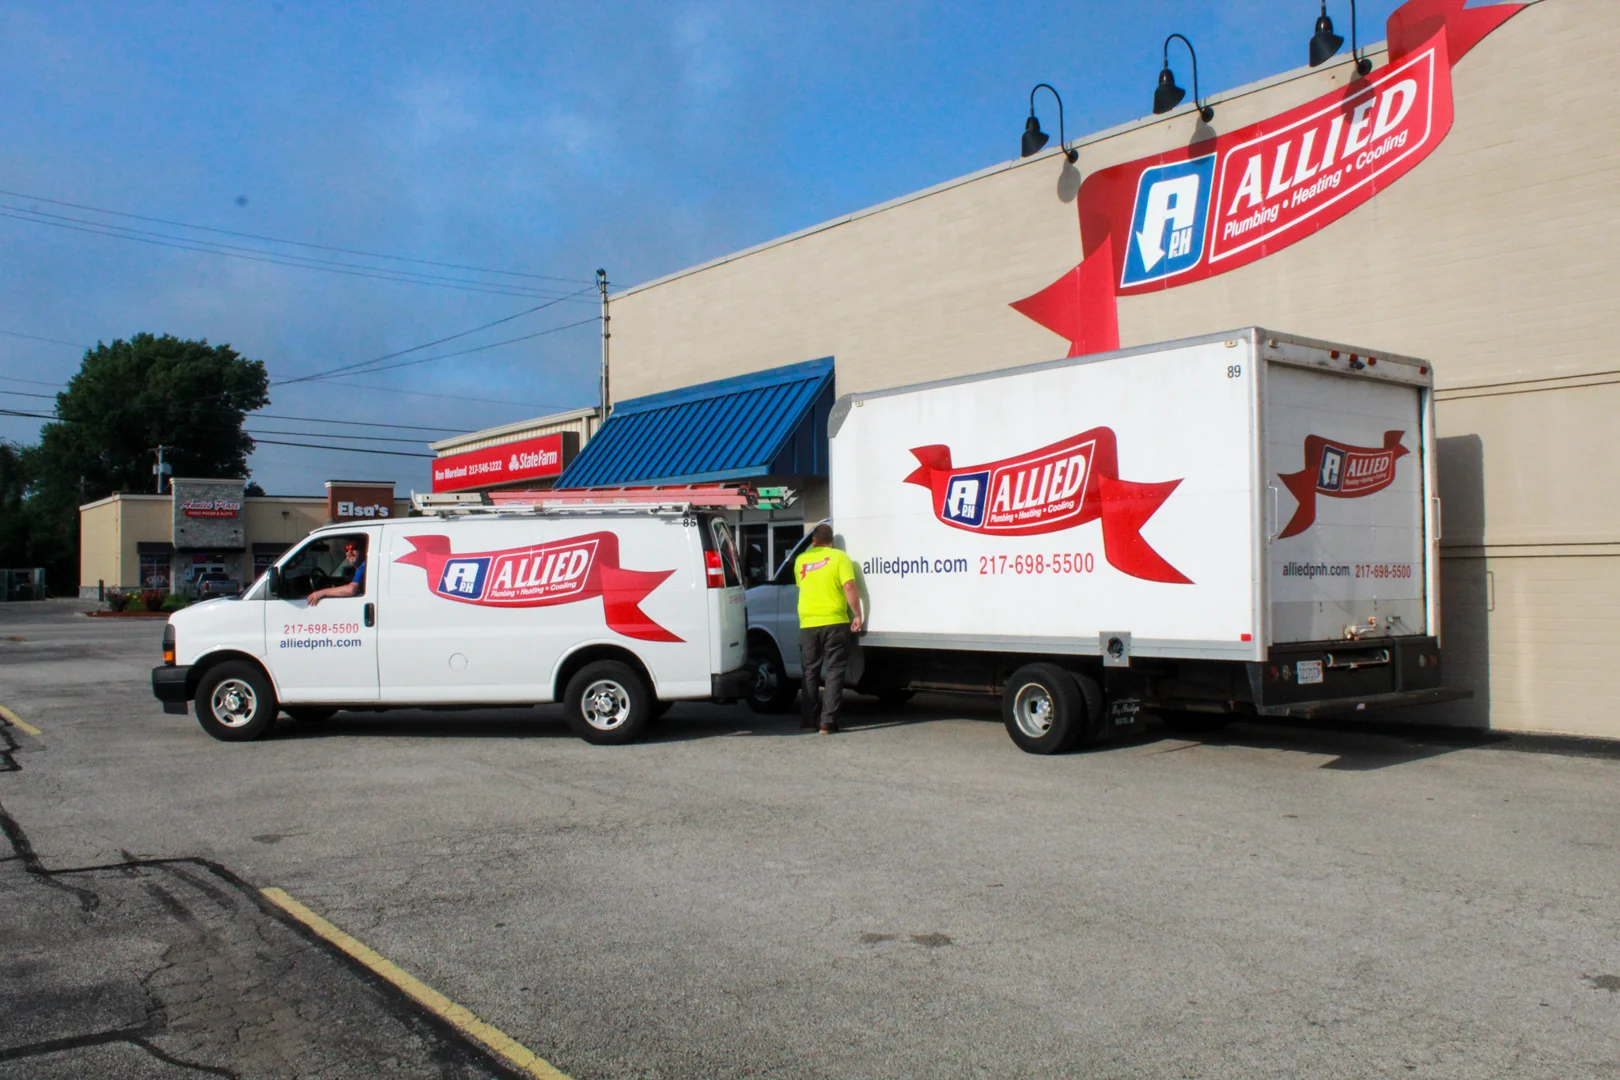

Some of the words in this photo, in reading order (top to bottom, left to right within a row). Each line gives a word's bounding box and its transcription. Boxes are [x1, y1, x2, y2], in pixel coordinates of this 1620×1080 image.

[1226, 78, 1418, 217] ALLIED
[1222, 201, 1280, 241] Plumbing
[1291, 169, 1342, 208] Heating
[1355, 129, 1409, 170] Cooling
[1227, 364, 1242, 379] 89
[1346, 456, 1390, 477] ALLIED
[992, 454, 1087, 513] ALLIED
[337, 501, 389, 517] Elsa's
[990, 512, 1014, 524] Plumbing
[1018, 508, 1042, 520] Heating
[1047, 500, 1075, 514] Cooling
[682, 518, 697, 528] 85
[493, 549, 590, 588] ALLIED
[863, 555, 967, 579] alliedpnh.com
[979, 552, 1095, 575] 217-698-5500
[1282, 562, 1350, 580] alliedpnh.com
[1355, 564, 1411, 579] 217-698-5500
[490, 588, 516, 598] Plumbing
[520, 586, 545, 596] Heating
[550, 581, 577, 592] Cooling
[283, 623, 359, 634] 217-698-5500
[279, 638, 362, 650] alliedpnh.com
